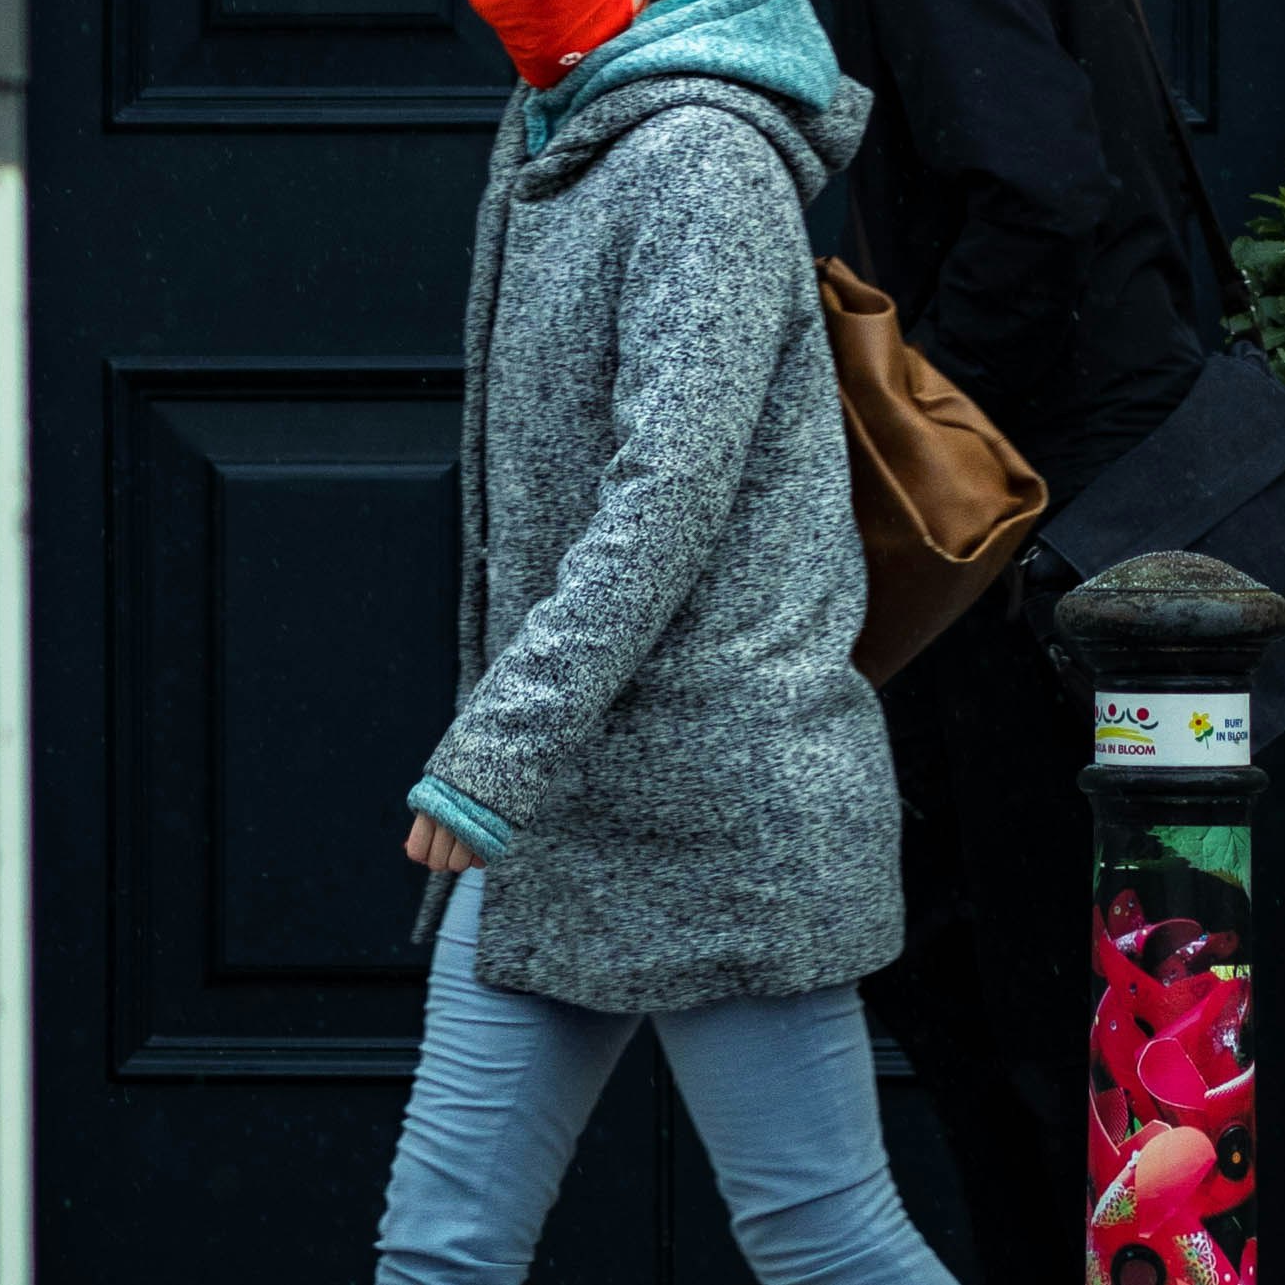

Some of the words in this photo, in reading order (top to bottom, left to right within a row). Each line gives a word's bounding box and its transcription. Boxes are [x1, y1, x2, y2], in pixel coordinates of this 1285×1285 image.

[1216, 731, 1226, 741] IN
[1108, 744, 1116, 755] IN
[1118, 744, 1156, 756] BLOOM
